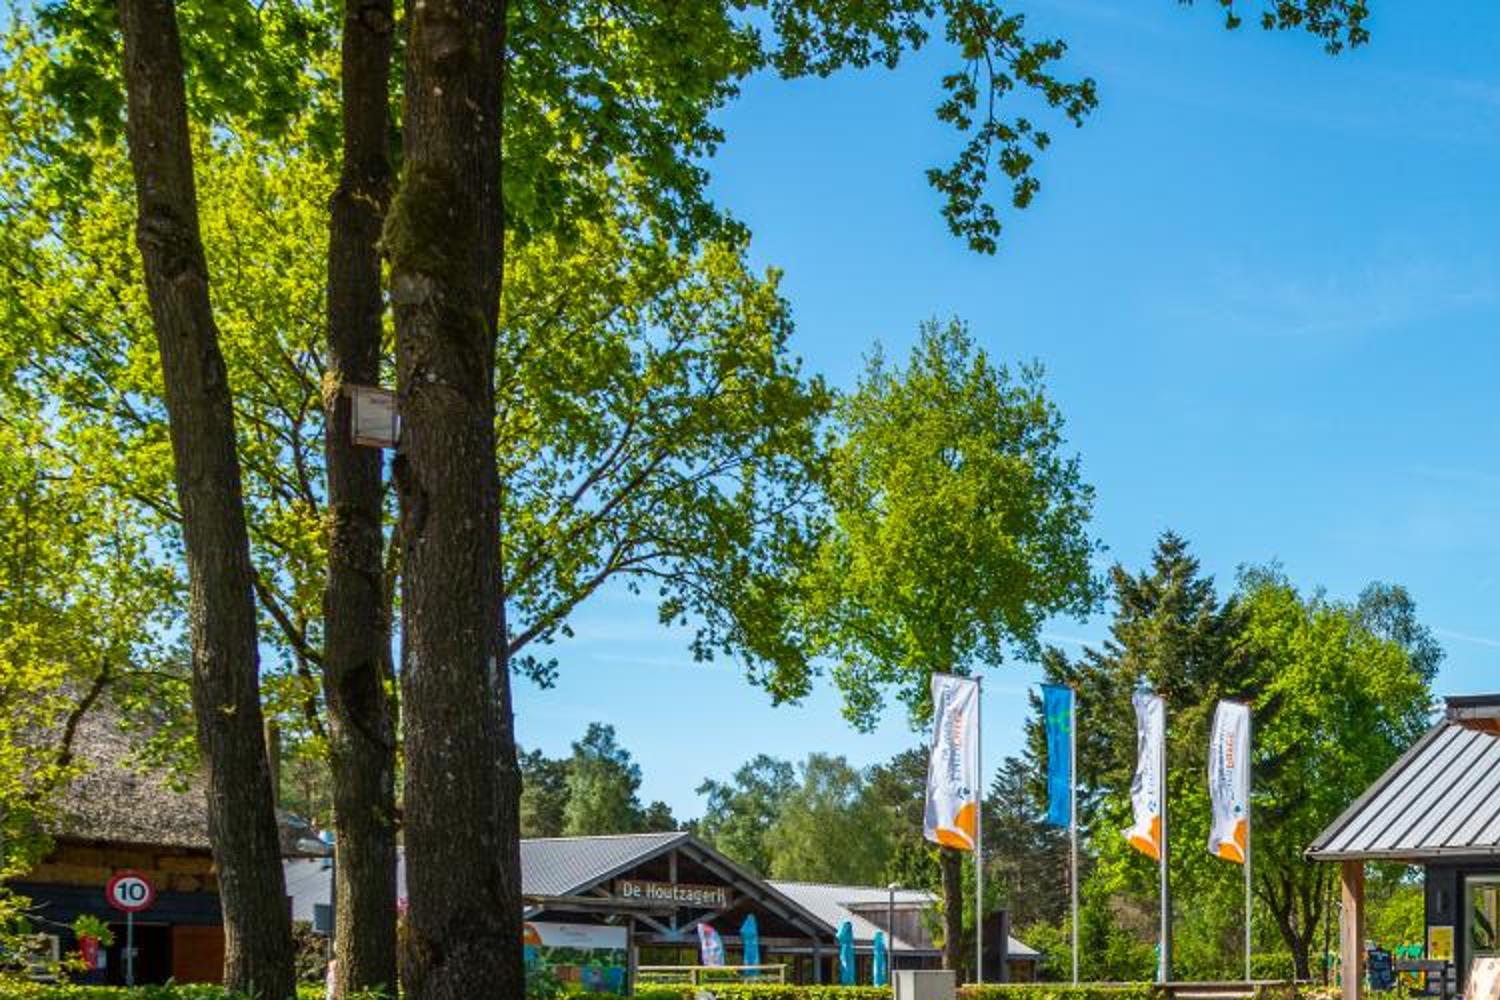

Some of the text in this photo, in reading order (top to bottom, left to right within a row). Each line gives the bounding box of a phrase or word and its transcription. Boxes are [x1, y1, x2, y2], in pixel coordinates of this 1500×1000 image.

[117, 882, 146, 901] 10
[623, 881, 727, 908] De Houtzagerij
